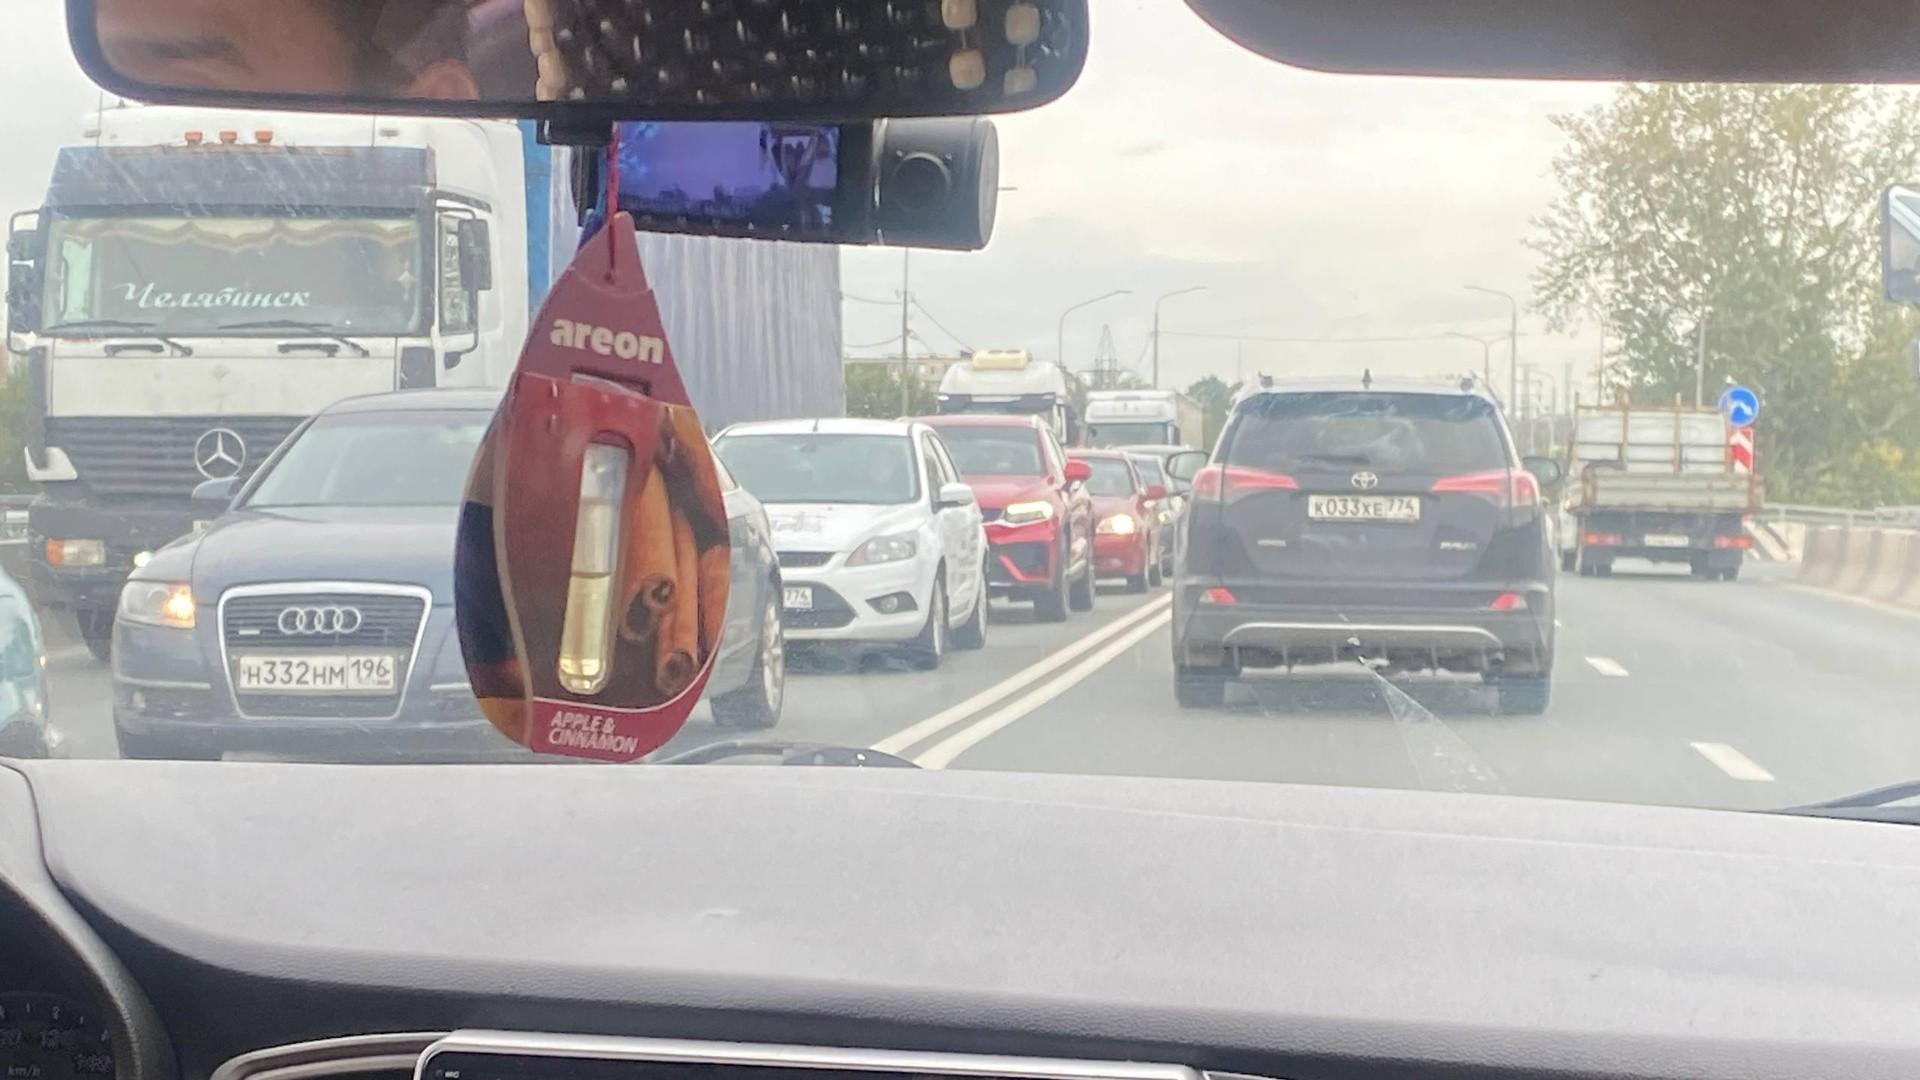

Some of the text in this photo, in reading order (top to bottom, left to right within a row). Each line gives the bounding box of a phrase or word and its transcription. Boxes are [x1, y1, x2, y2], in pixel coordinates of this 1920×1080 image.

[113, 282, 311, 309] Челябинск
[550, 318, 664, 365] areon
[551, 711, 616, 734] APPLE &
[548, 727, 639, 754] CINNAMON
